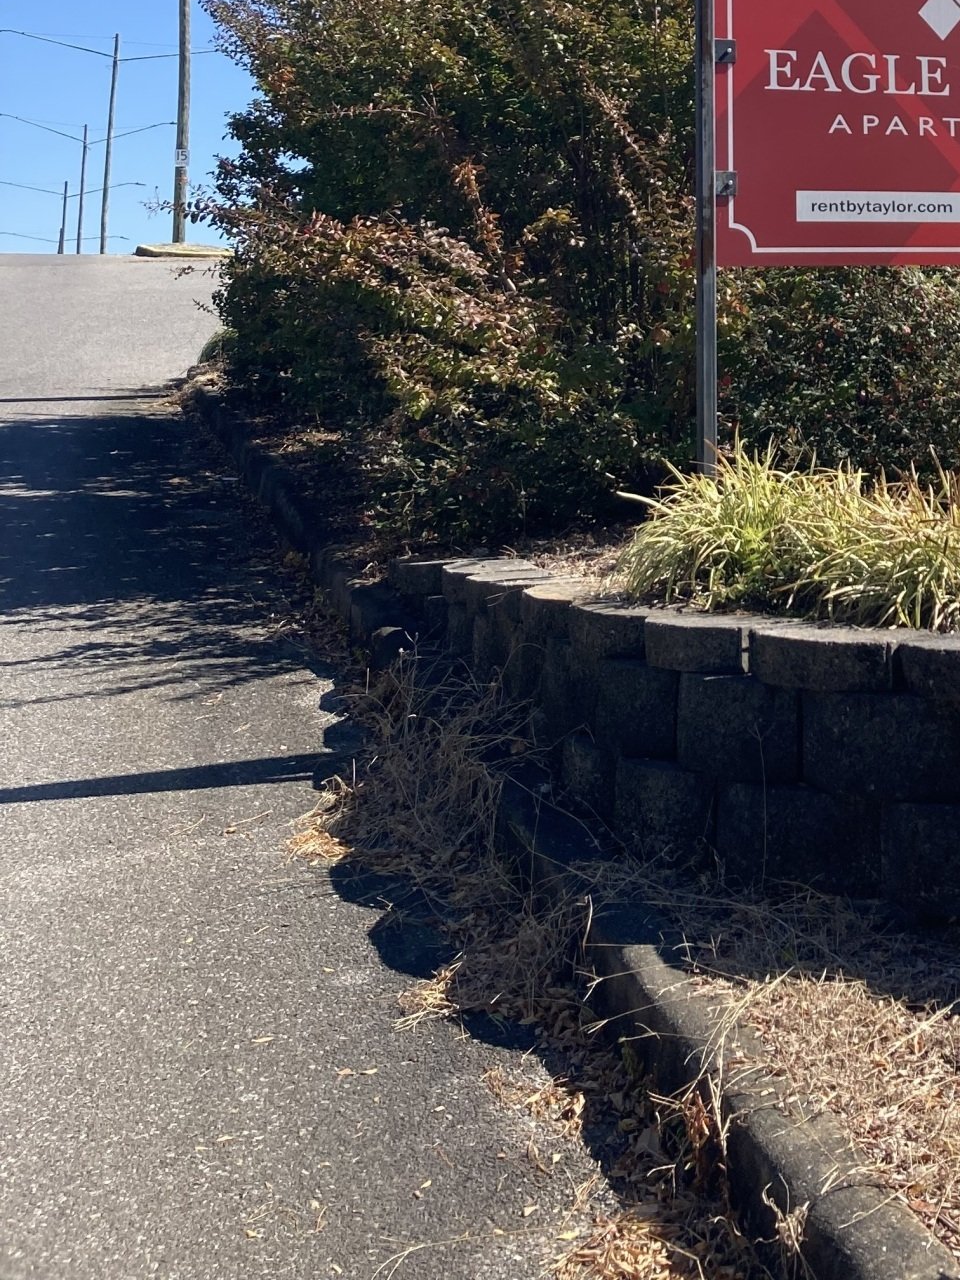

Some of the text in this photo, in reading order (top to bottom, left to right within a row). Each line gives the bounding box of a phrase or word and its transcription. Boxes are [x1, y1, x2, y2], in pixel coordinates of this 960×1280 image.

[763, 48, 951, 96] EAGLE
[176, 150, 188, 161] 15
[811, 200, 953, 216] rentbytaylor.com
